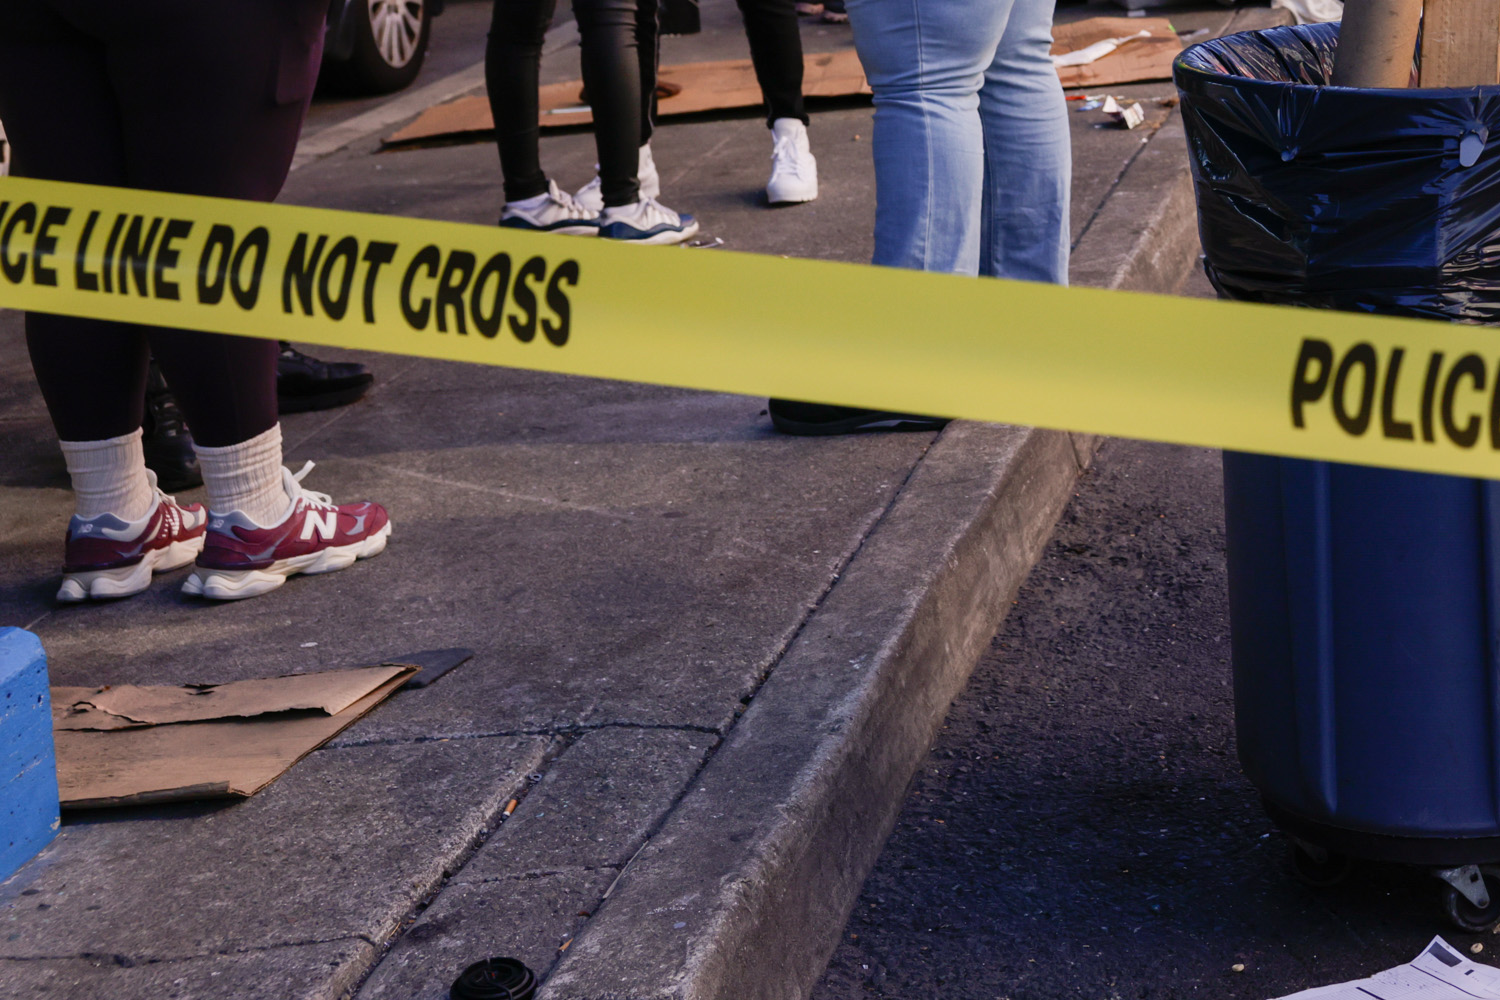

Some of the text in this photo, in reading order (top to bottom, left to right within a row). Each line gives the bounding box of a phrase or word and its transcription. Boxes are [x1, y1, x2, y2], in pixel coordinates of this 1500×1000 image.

[75, 210, 194, 301] LINE
[197, 224, 269, 310] DO
[282, 232, 397, 323] NOT
[400, 245, 580, 347] CROSS
